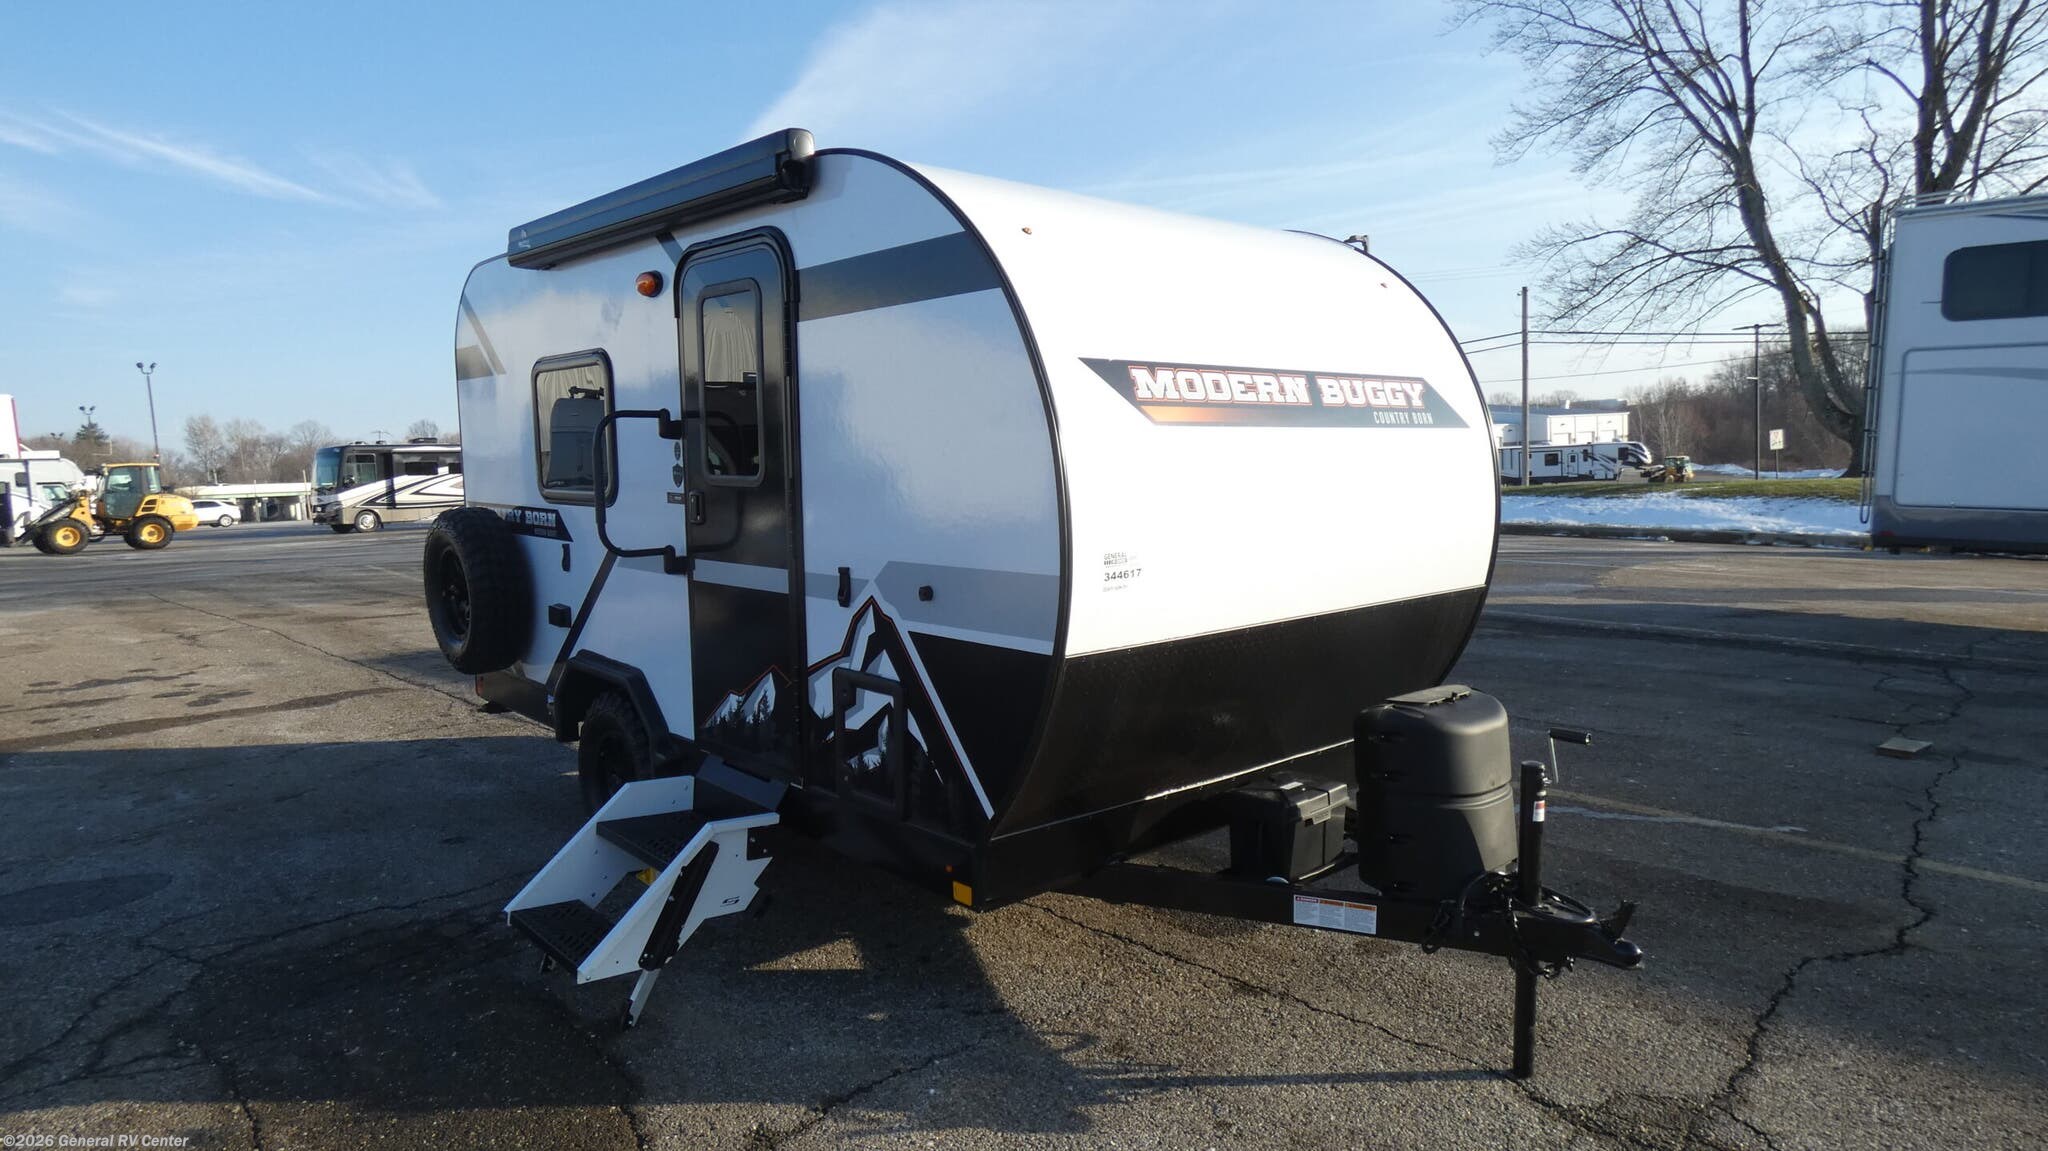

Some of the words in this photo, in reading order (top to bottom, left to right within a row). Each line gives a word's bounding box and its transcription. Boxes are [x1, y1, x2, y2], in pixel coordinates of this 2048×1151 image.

[1128, 366, 1312, 405] MODERN
[1315, 376, 1426, 408] BUGGY
[1373, 411, 1410, 424] COUNTRY
[525, 511, 556, 527] BORN
[1104, 568, 1142, 582] 344617
